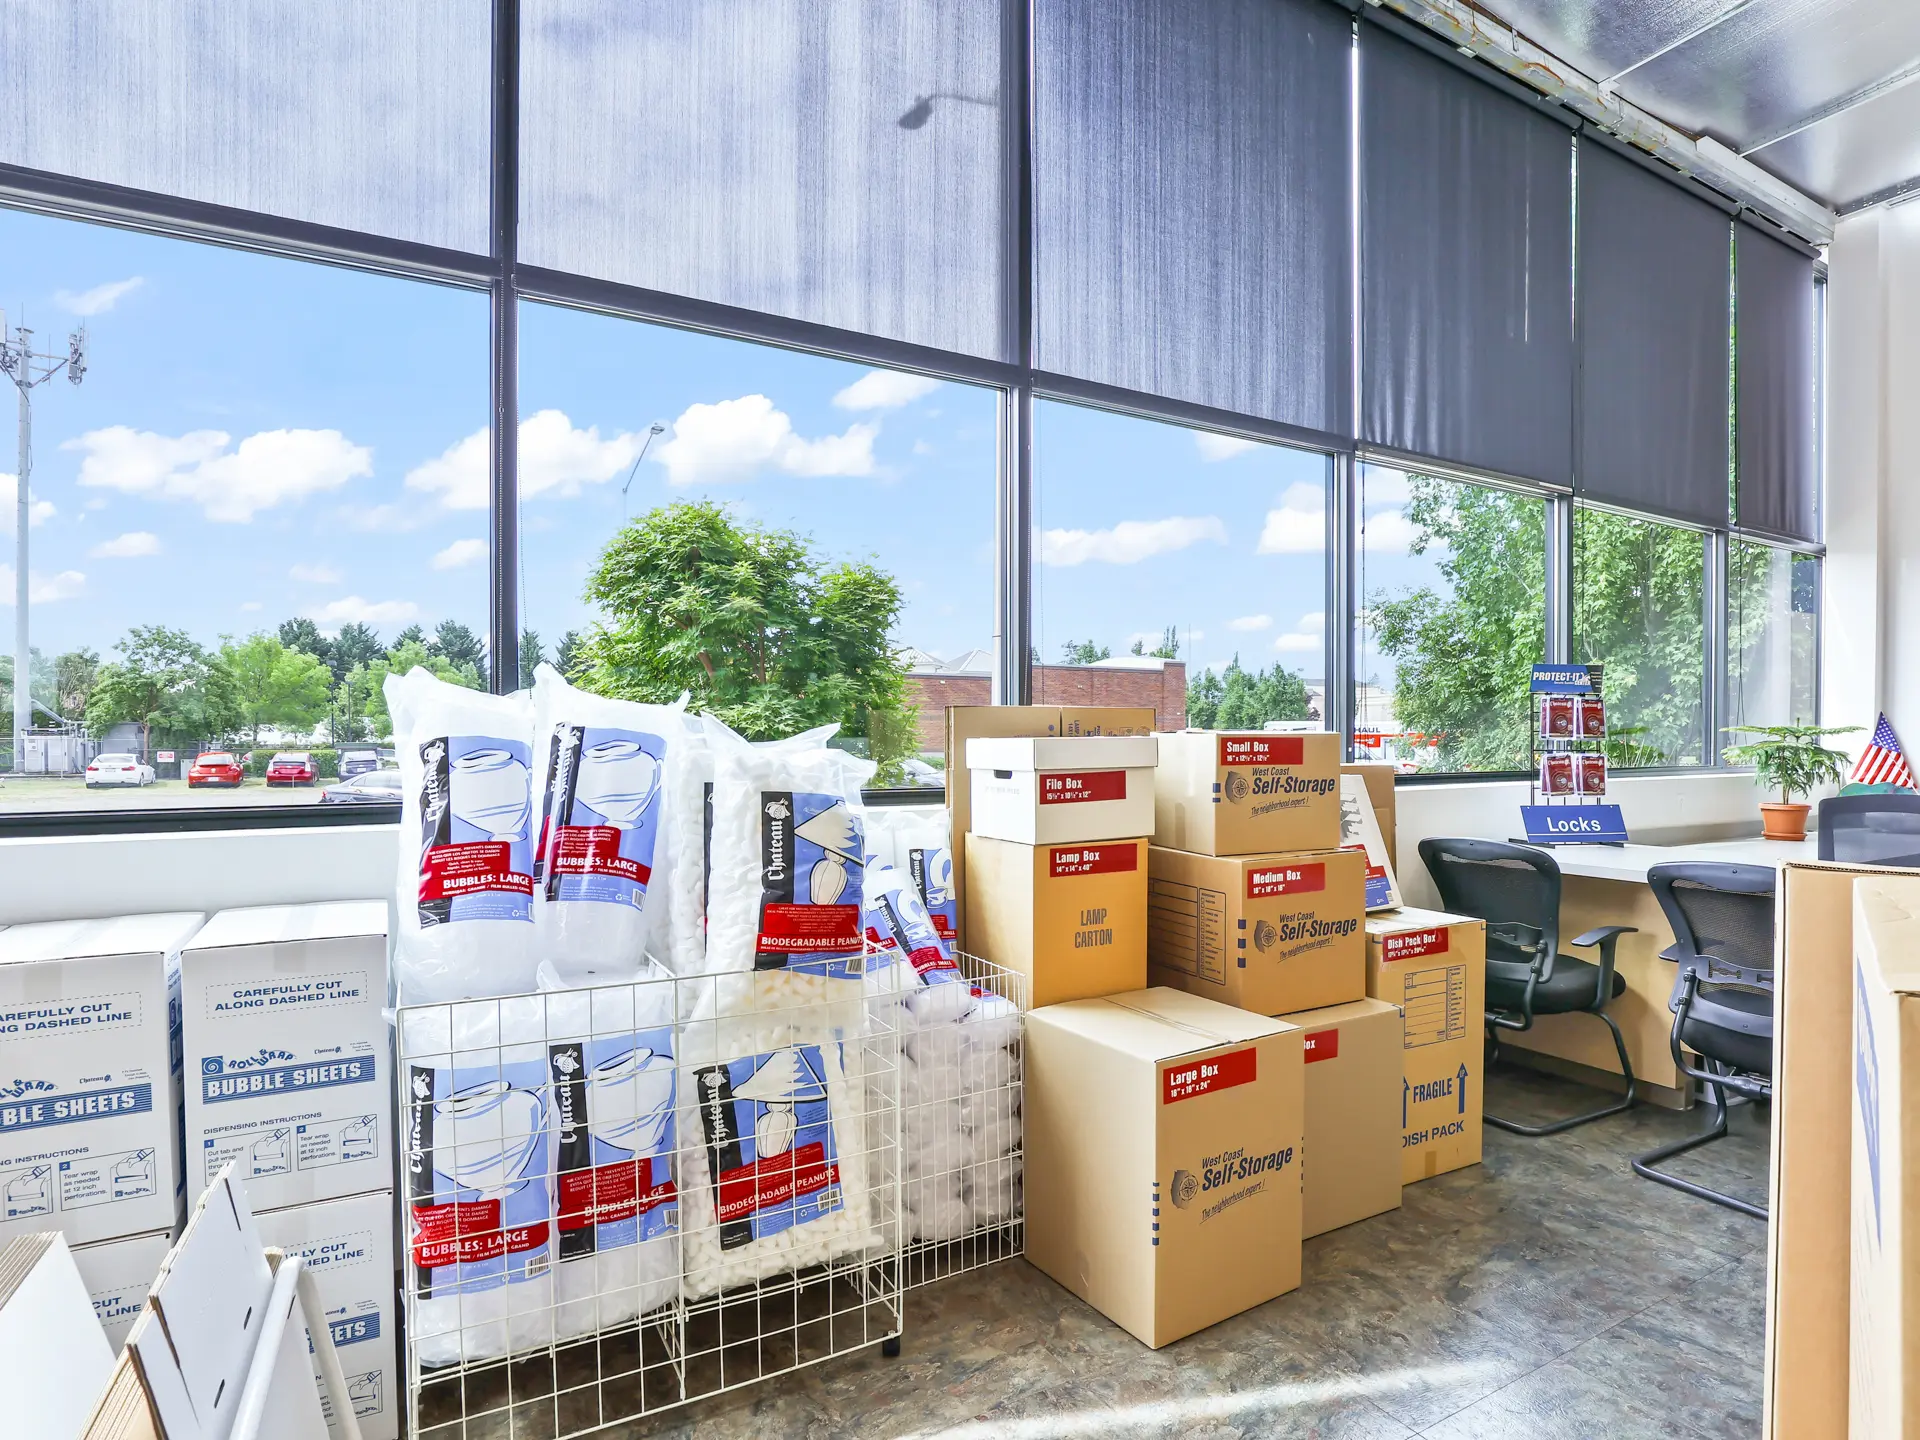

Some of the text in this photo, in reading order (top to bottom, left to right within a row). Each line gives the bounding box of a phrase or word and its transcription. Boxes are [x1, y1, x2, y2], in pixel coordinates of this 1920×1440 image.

[1533, 672, 1581, 681] PROTECT-IT
[1227, 741, 1269, 752] Small Box
[1252, 767, 1289, 776] West Coast
[1046, 778, 1083, 790] File Box
[1252, 776, 1335, 795] Self-Storage
[1251, 806, 1260, 815] The
[1259, 798, 1290, 813] neighborhood
[1546, 817, 1602, 832] Locks
[767, 820, 787, 880] Chateau
[1056, 850, 1100, 864] Lamp Box
[607, 859, 638, 872] LARGE
[443, 873, 530, 889] BUBBLES: LARGE
[1253, 870, 1301, 884] Medium Box
[1081, 908, 1107, 926] LAMP
[1280, 911, 1315, 923] West Coast
[1074, 928, 1112, 949] CARTON
[1280, 918, 1357, 942] Self-Storage
[761, 937, 835, 947] BIODEGRADABLE
[1287, 939, 1315, 957] neighborhood
[1388, 934, 1436, 949] Dish Pack Box
[233, 981, 343, 998] CAREFULLY CUT
[215, 989, 359, 1011] ALONG DASHED LINE
[0, 1003, 112, 1022] REFULLY CUT
[25, 1016, 92, 1032] DASHED
[97, 1012, 132, 1024] LINE
[1304, 1040, 1316, 1050] ox
[228, 1056, 260, 1069] ROLL
[257, 1051, 294, 1066] WRAP
[207, 1063, 361, 1097] BUBBLE SHEETS
[1170, 1064, 1219, 1086] Large Box
[11, 1081, 55, 1098] WRAP
[1171, 1087, 1181, 1098] 18"
[1186, 1084, 1196, 1094] 18"
[1200, 1080, 1211, 1090] 24"
[1413, 1077, 1452, 1104] FRAGILE
[0, 1092, 135, 1127] BLE SHEETS
[204, 1112, 322, 1135] DISPENSING INSTRUCTIONS
[1432, 1120, 1464, 1140] PACK
[308, 1139, 331, 1147] needed
[315, 1133, 330, 1141] wrap
[15, 1146, 89, 1163] INSTRUCTIONS
[221, 1155, 236, 1163] wrap
[1202, 1147, 1244, 1170] West Coast
[81, 1170, 98, 1178] wrap
[1202, 1147, 1293, 1191] Self-Storage
[75, 1176, 100, 1185] needed
[64, 1190, 108, 1201] perforations.
[642, 1186, 665, 1204] LGE
[720, 1181, 794, 1214] BIODEGRADABLE
[797, 1168, 835, 1188] PEANUTS
[1202, 1209, 1211, 1220] The
[1211, 1188, 1245, 1213] neighborhood
[321, 1242, 347, 1254] CUT
[422, 1230, 529, 1258] BUBBLES: LARGE
[335, 1249, 365, 1262] LINE
[92, 1297, 122, 1309] CUT
[107, 1304, 142, 1318] LINE
[329, 1321, 366, 1342] ETS
